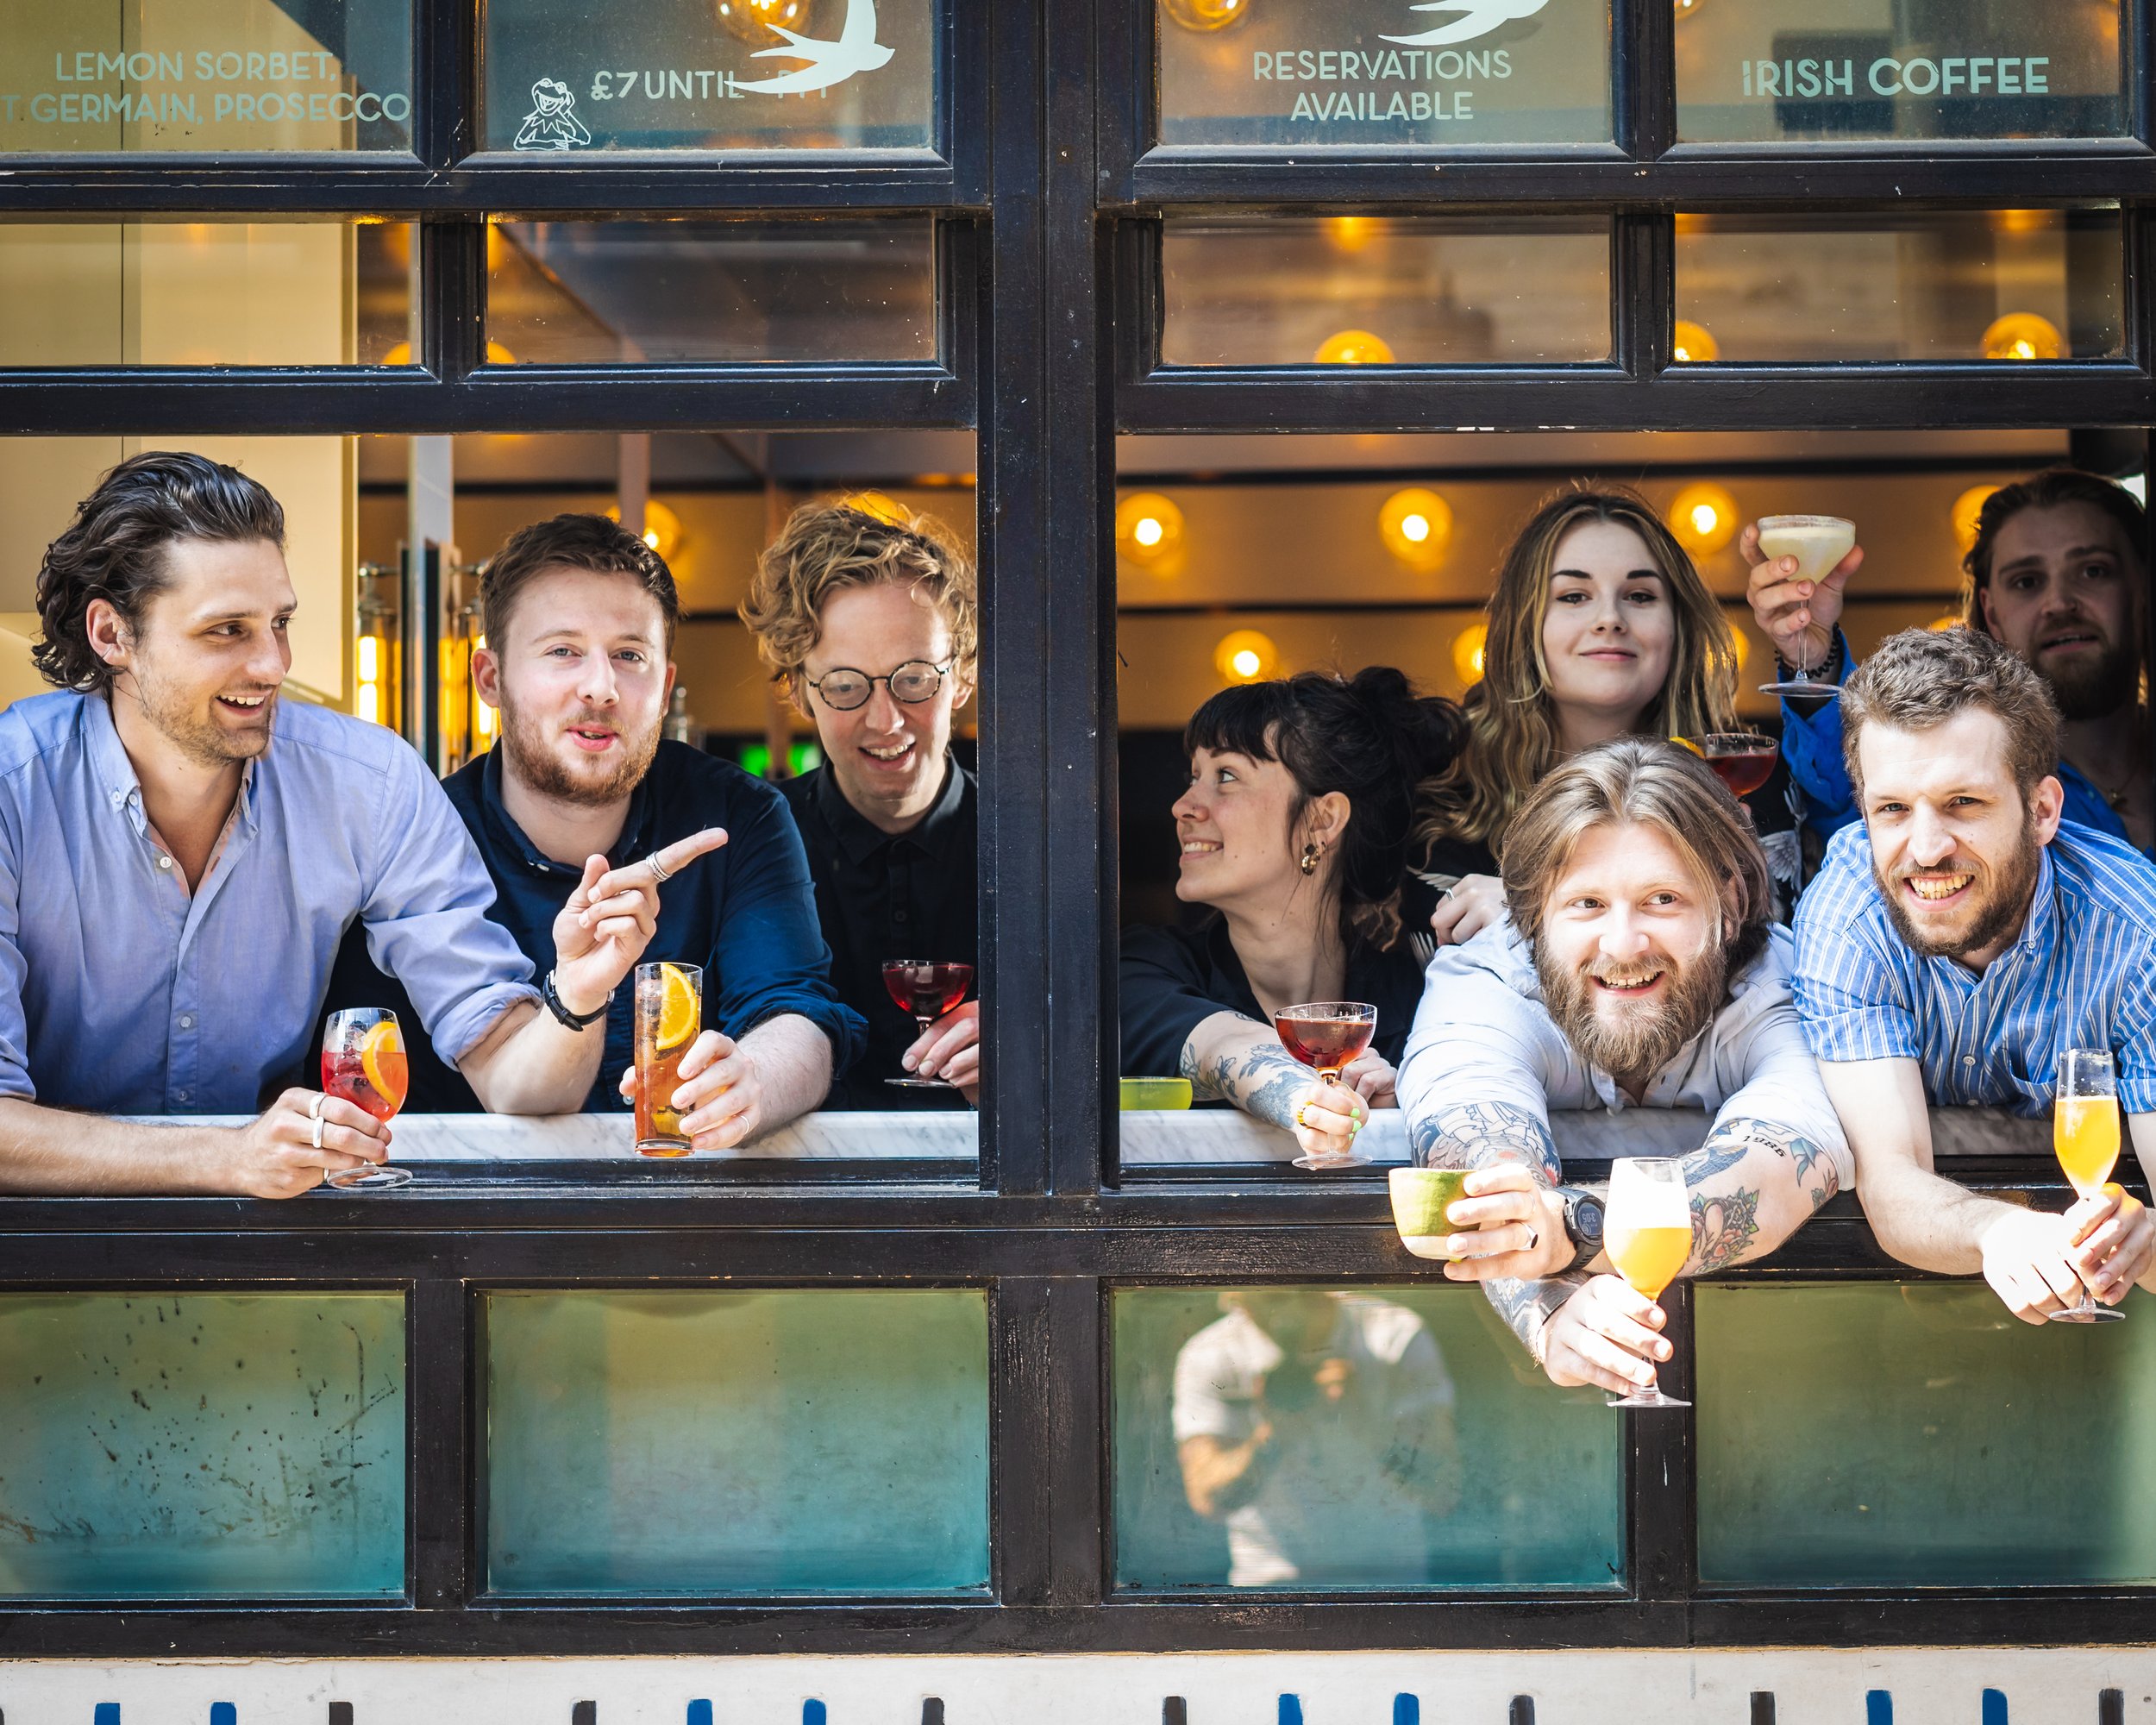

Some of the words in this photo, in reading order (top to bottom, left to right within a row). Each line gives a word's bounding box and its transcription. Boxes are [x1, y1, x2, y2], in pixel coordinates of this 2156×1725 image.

[56, 51, 183, 81] LEMON
[195, 51, 336, 83] SORBET,
[1253, 49, 1513, 81] RESERVATIONS
[1742, 60, 1853, 97] IRISH
[1868, 57, 2050, 96] COFFEE
[644, 70, 745, 99] UNTIL
[30, 92, 204, 125] GERMAIN,
[215, 92, 411, 122] PROSECCO
[1290, 91, 1474, 122] AVAILABLE
